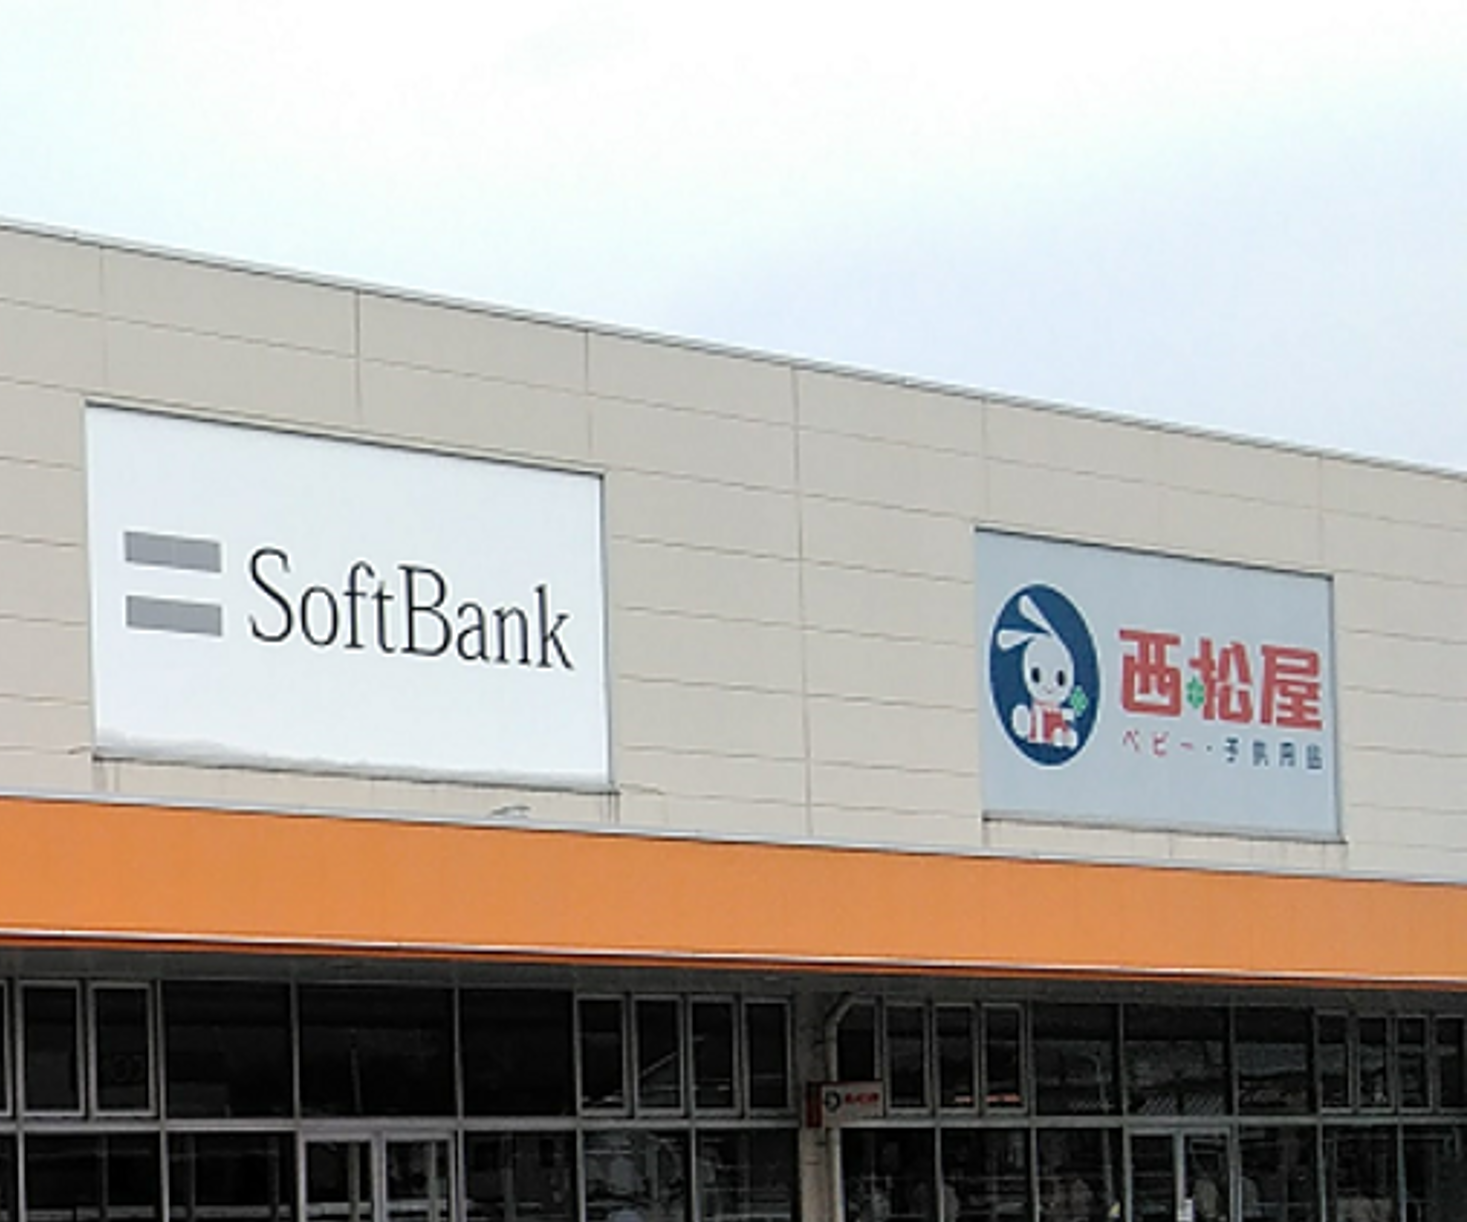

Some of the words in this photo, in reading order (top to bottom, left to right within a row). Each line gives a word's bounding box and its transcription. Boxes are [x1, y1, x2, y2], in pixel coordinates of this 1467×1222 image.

[248, 546, 574, 671] SoftBank
[1118, 629, 1323, 731] 西松屋
